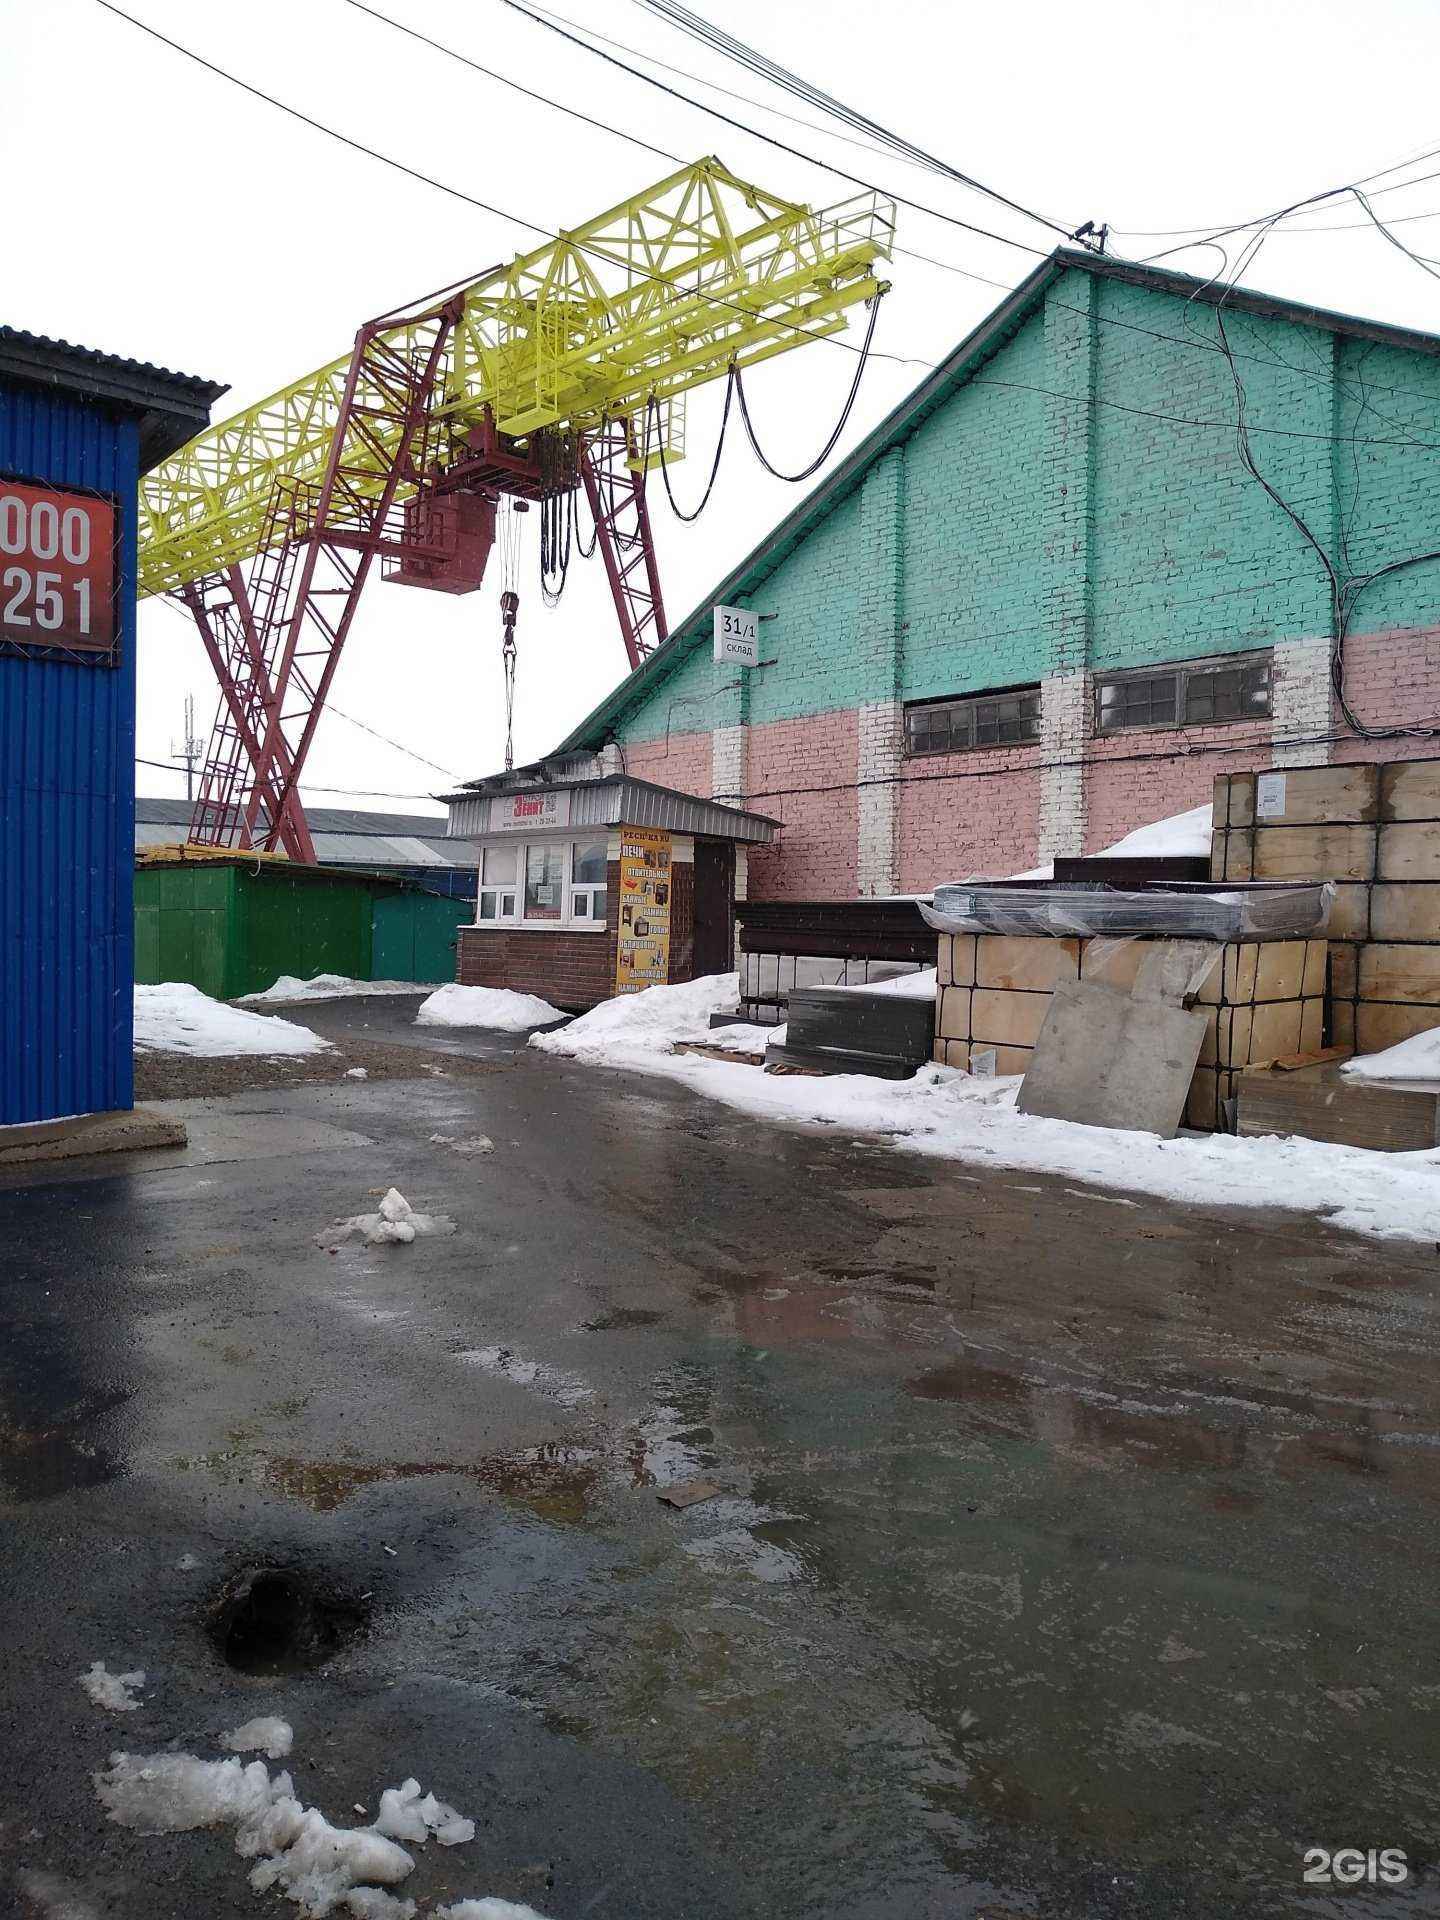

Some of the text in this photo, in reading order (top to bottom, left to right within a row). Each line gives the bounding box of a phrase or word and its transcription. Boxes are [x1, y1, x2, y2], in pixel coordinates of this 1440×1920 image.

[3, 567, 90, 634] 251
[723, 615, 755, 638] 31/1
[726, 643, 753, 656] склад
[622, 845, 645, 858] ПЕЧИ
